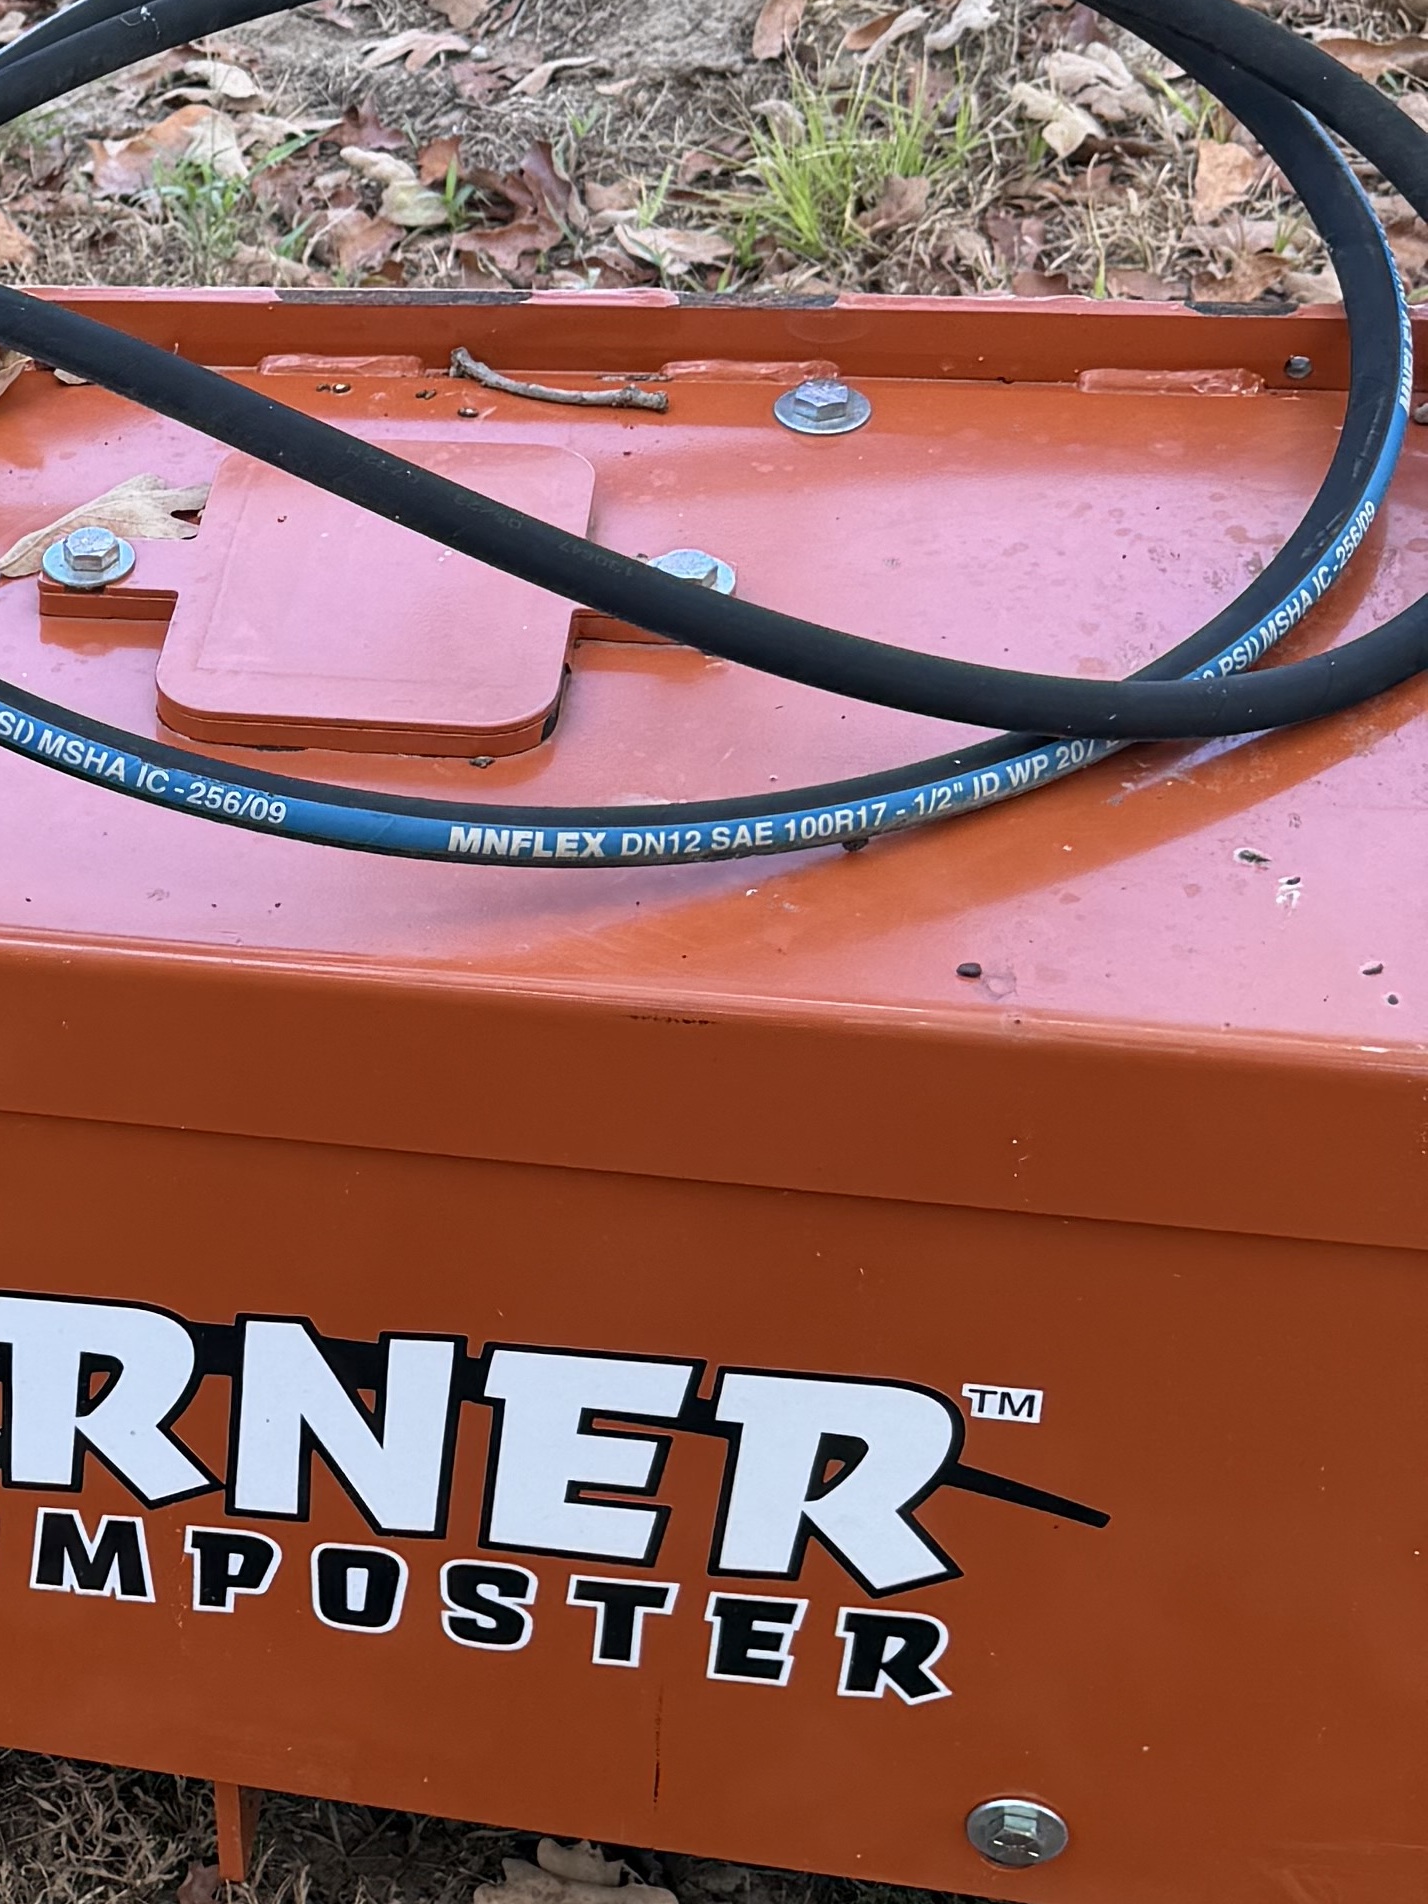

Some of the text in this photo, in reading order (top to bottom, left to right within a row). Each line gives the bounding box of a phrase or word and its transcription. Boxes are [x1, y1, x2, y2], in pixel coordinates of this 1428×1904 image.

[1218, 636, 1260, 677] PSI)
[1259, 589, 1313, 652] MSHA
[37, 730, 126, 783] MSHA
[448, 826, 606, 859] MNFLEX
[620, 830, 702, 857] DN12
[711, 821, 773, 851] SAE
[784, 802, 887, 843] 100R17
[913, 782, 963, 816] 1/2"
[973, 771, 1001, 800] ID
[1006, 756, 1049, 788] WP
[967, 1388, 1036, 1418] TM
